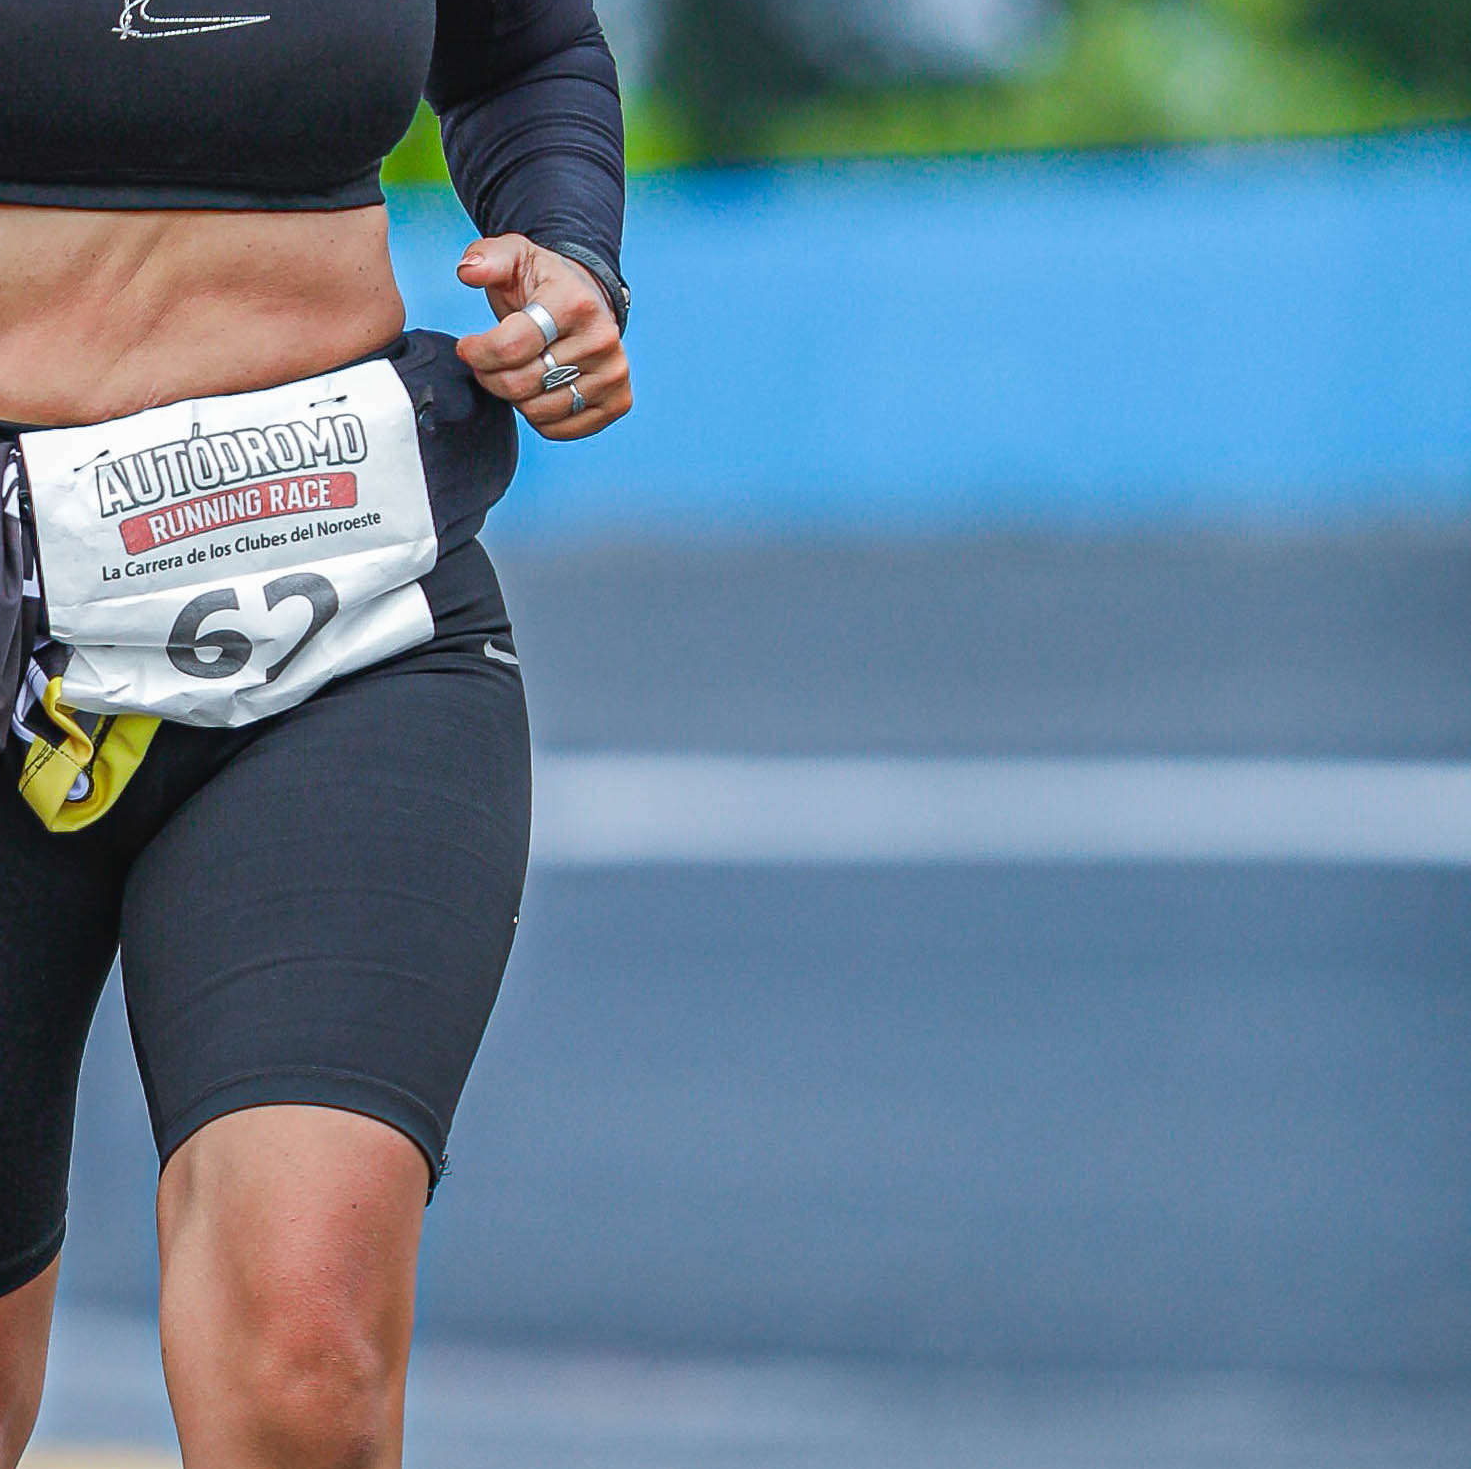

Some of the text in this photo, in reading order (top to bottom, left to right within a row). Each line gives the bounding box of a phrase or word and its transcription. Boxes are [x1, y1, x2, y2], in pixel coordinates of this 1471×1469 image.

[96, 415, 367, 518] AUTÓDROMO
[102, 511, 382, 582] La Carrera de los Clubes del Noroeste
[148, 479, 331, 545] RUNNING RACE
[165, 572, 339, 684] 62
